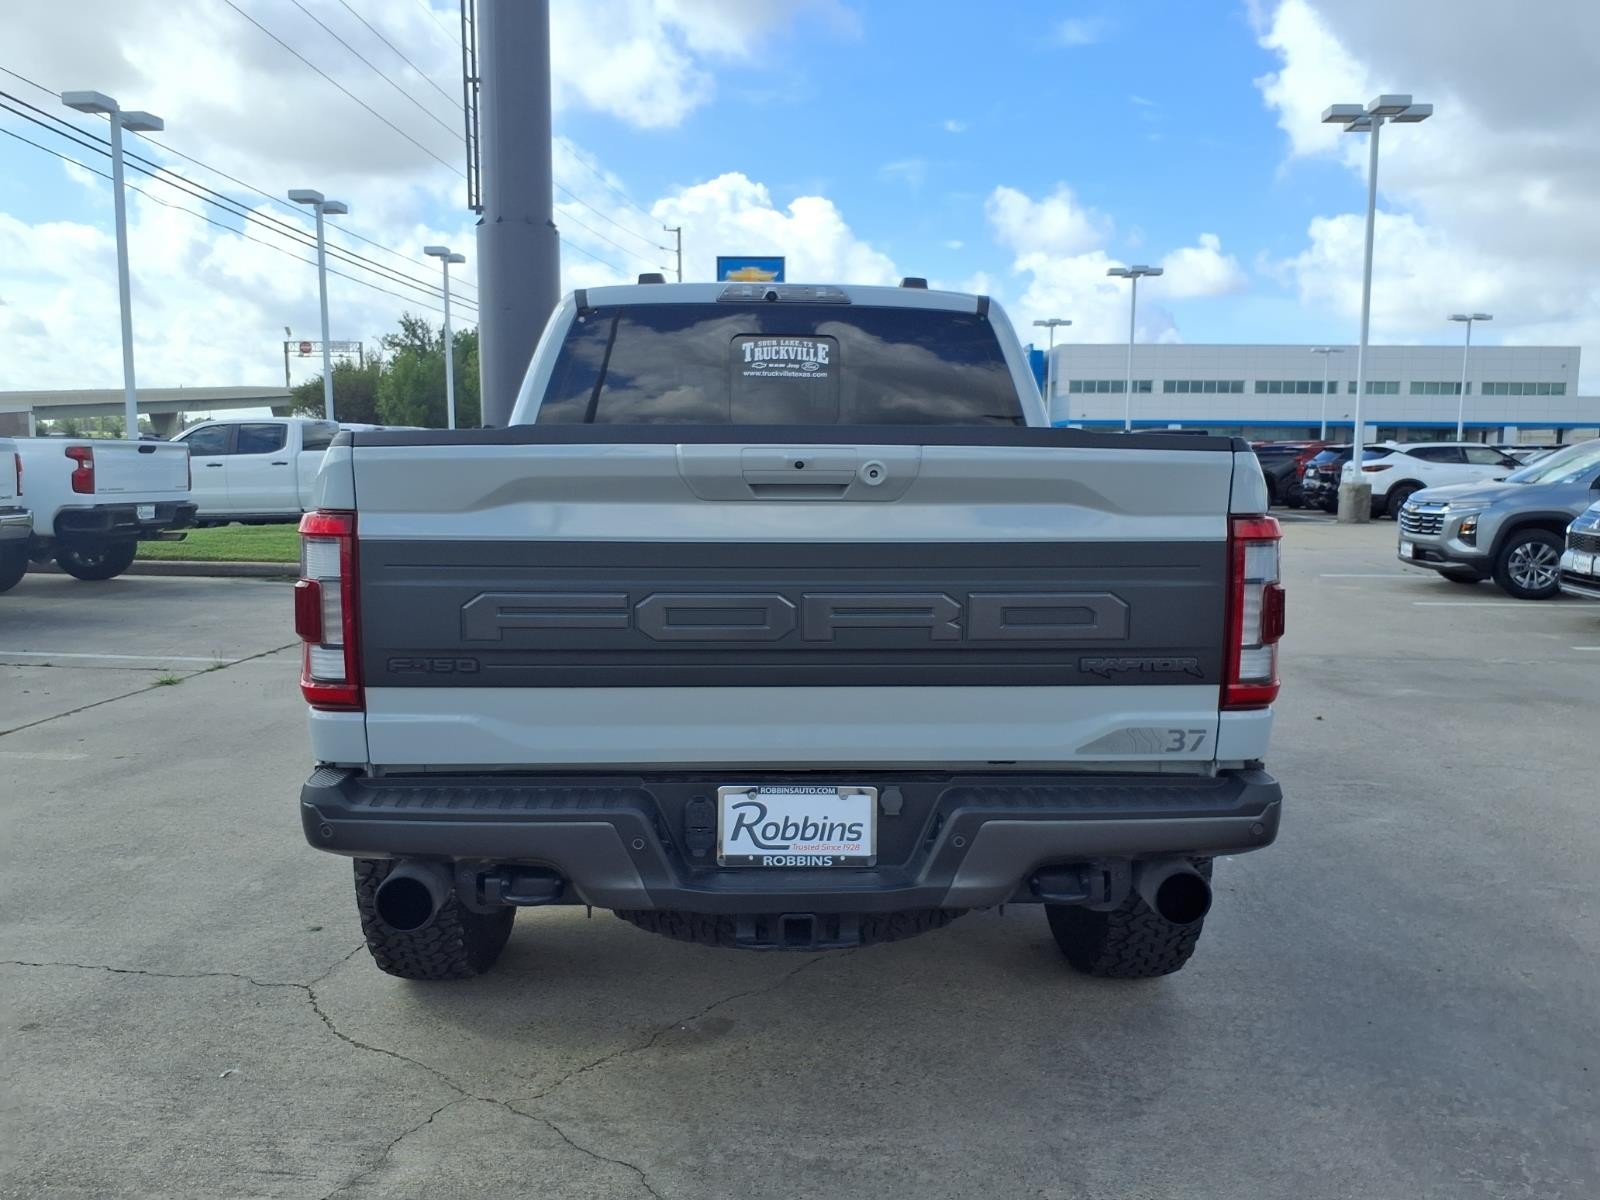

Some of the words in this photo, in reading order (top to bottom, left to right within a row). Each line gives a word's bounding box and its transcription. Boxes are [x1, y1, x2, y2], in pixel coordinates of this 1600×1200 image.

[742, 342, 829, 365] TRUCKVILLE
[461, 592, 1130, 643] FORD
[387, 657, 480, 673] F-150
[1079, 656, 1205, 679] RAPTOR
[1165, 728, 1207, 753] 37
[760, 786, 836, 795] ROBBINSAUTO.COM
[730, 801, 864, 850] Robbins
[792, 843, 820, 851] Trusted
[821, 843, 841, 851] Since
[843, 843, 861, 851] 1928
[763, 855, 833, 867] ROBBINS
